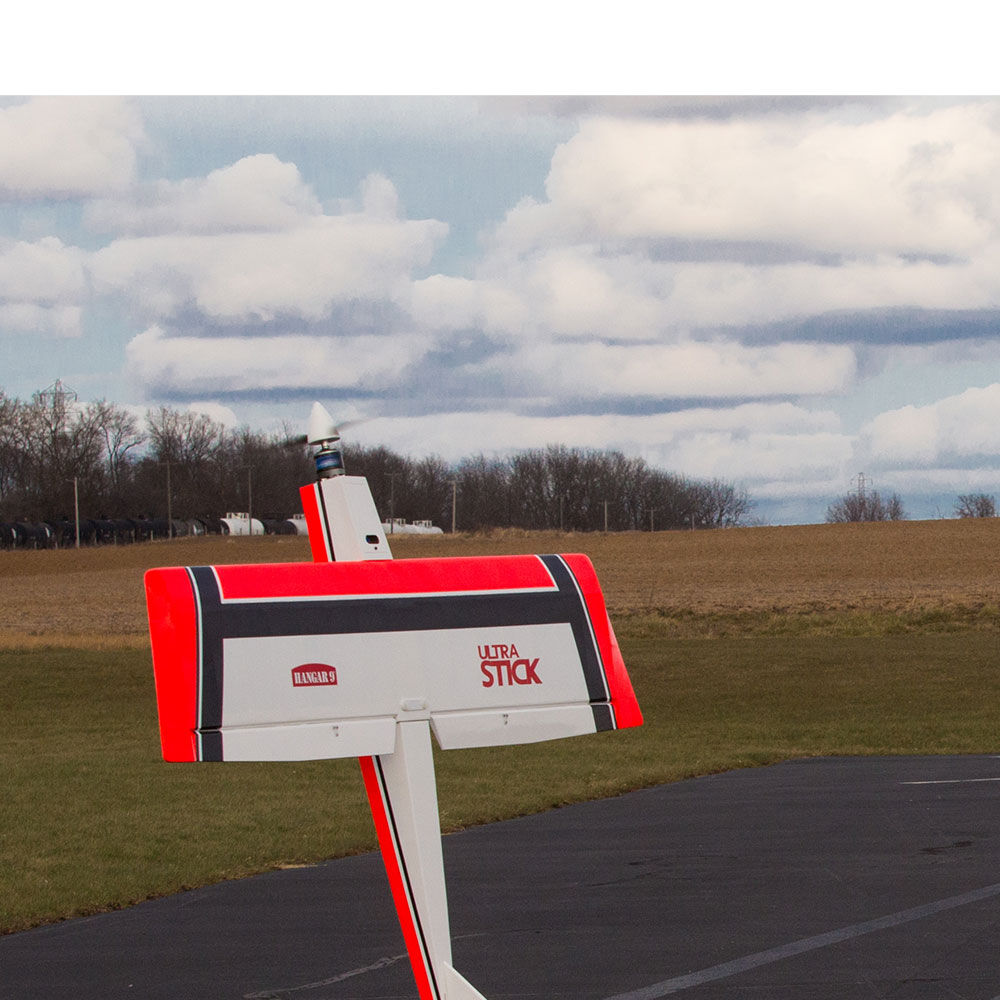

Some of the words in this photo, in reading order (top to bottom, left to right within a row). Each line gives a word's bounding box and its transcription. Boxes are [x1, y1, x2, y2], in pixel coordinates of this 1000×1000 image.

[477, 643, 520, 660] ULTRA
[294, 671, 329, 684] HANGAR
[328, 670, 336, 683] 9
[480, 657, 543, 688] STICK
